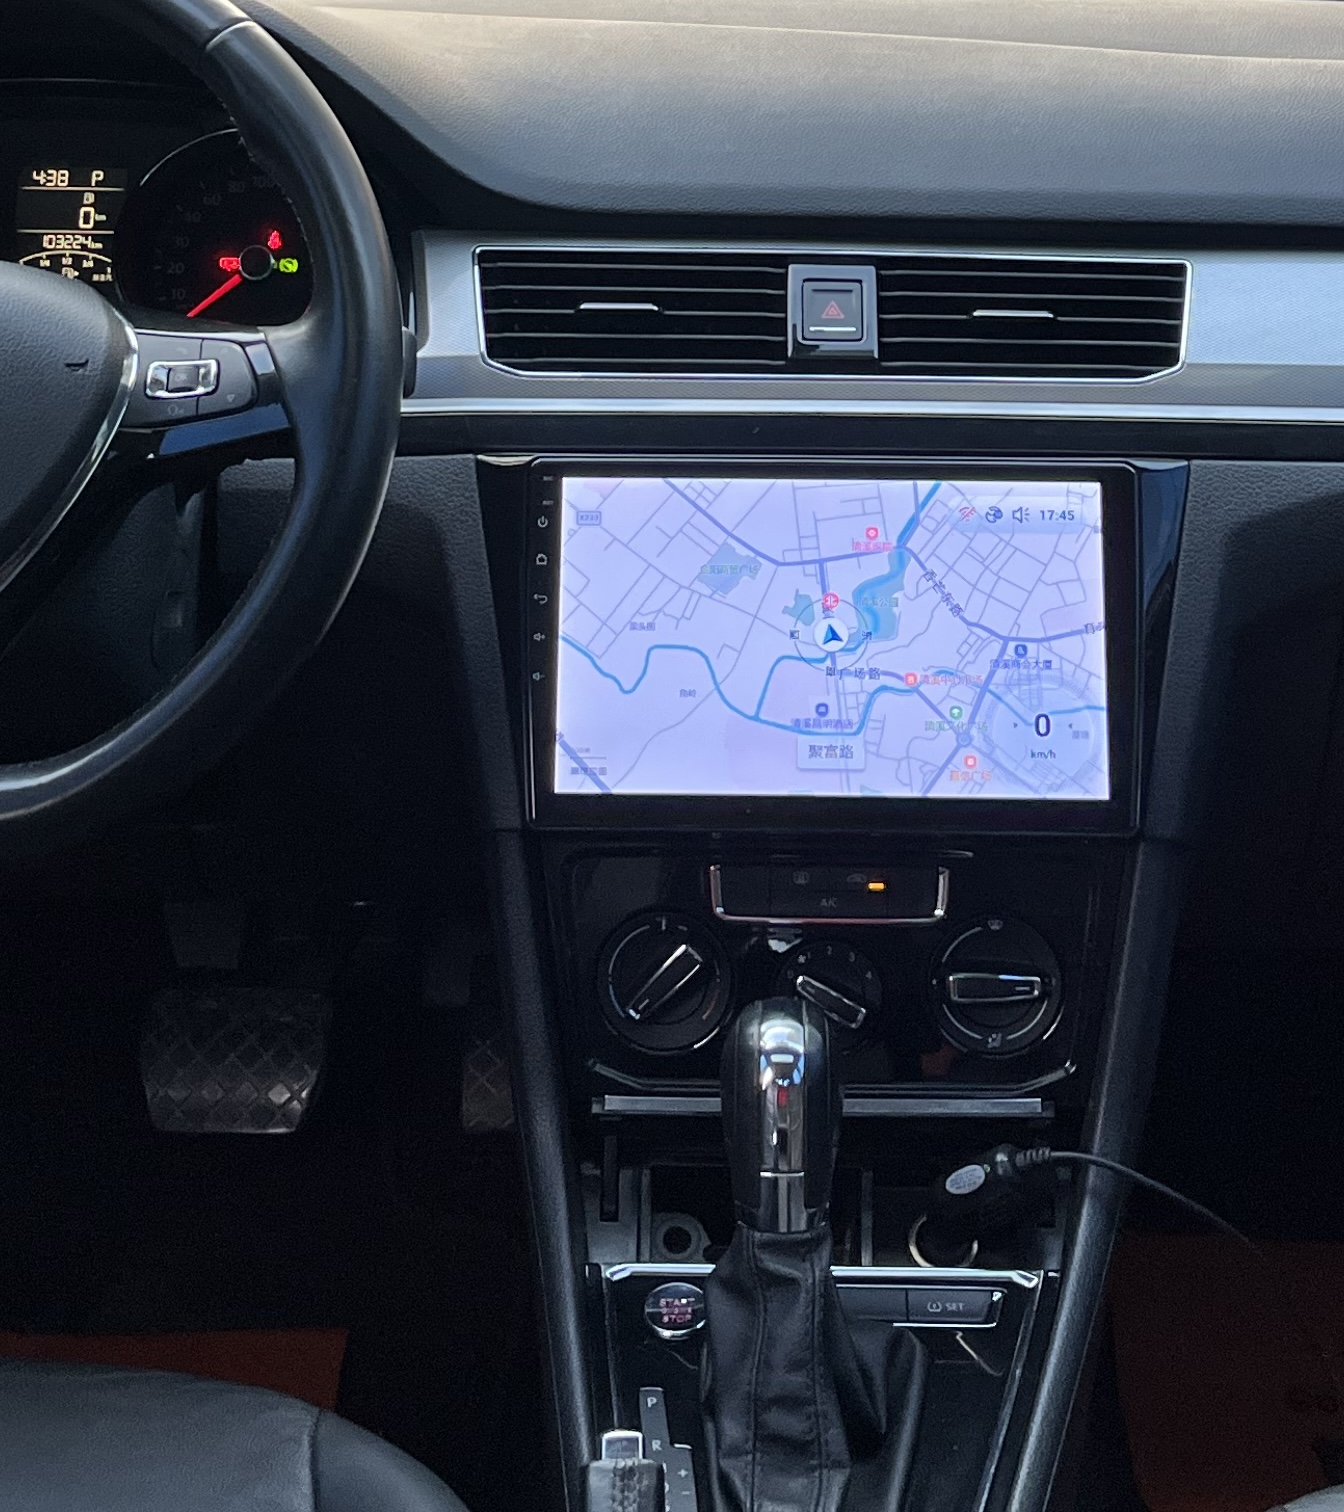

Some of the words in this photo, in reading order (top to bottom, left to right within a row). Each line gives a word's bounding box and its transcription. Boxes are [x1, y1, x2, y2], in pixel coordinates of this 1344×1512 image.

[32, 169, 69, 187] 4:38
[91, 170, 104, 187] P
[78, 206, 95, 229] 0
[42, 234, 92, 249] 103224
[1039, 510, 1075, 521] 17:45
[1034, 713, 1051, 737] 0
[808, 744, 854, 760] 聚富路
[1030, 749, 1056, 759] km/h
[945, 1301, 966, 1312] SET
[661, 1314, 692, 1324] STOP
[646, 1396, 657, 1408] P
[651, 1439, 662, 1451] R
